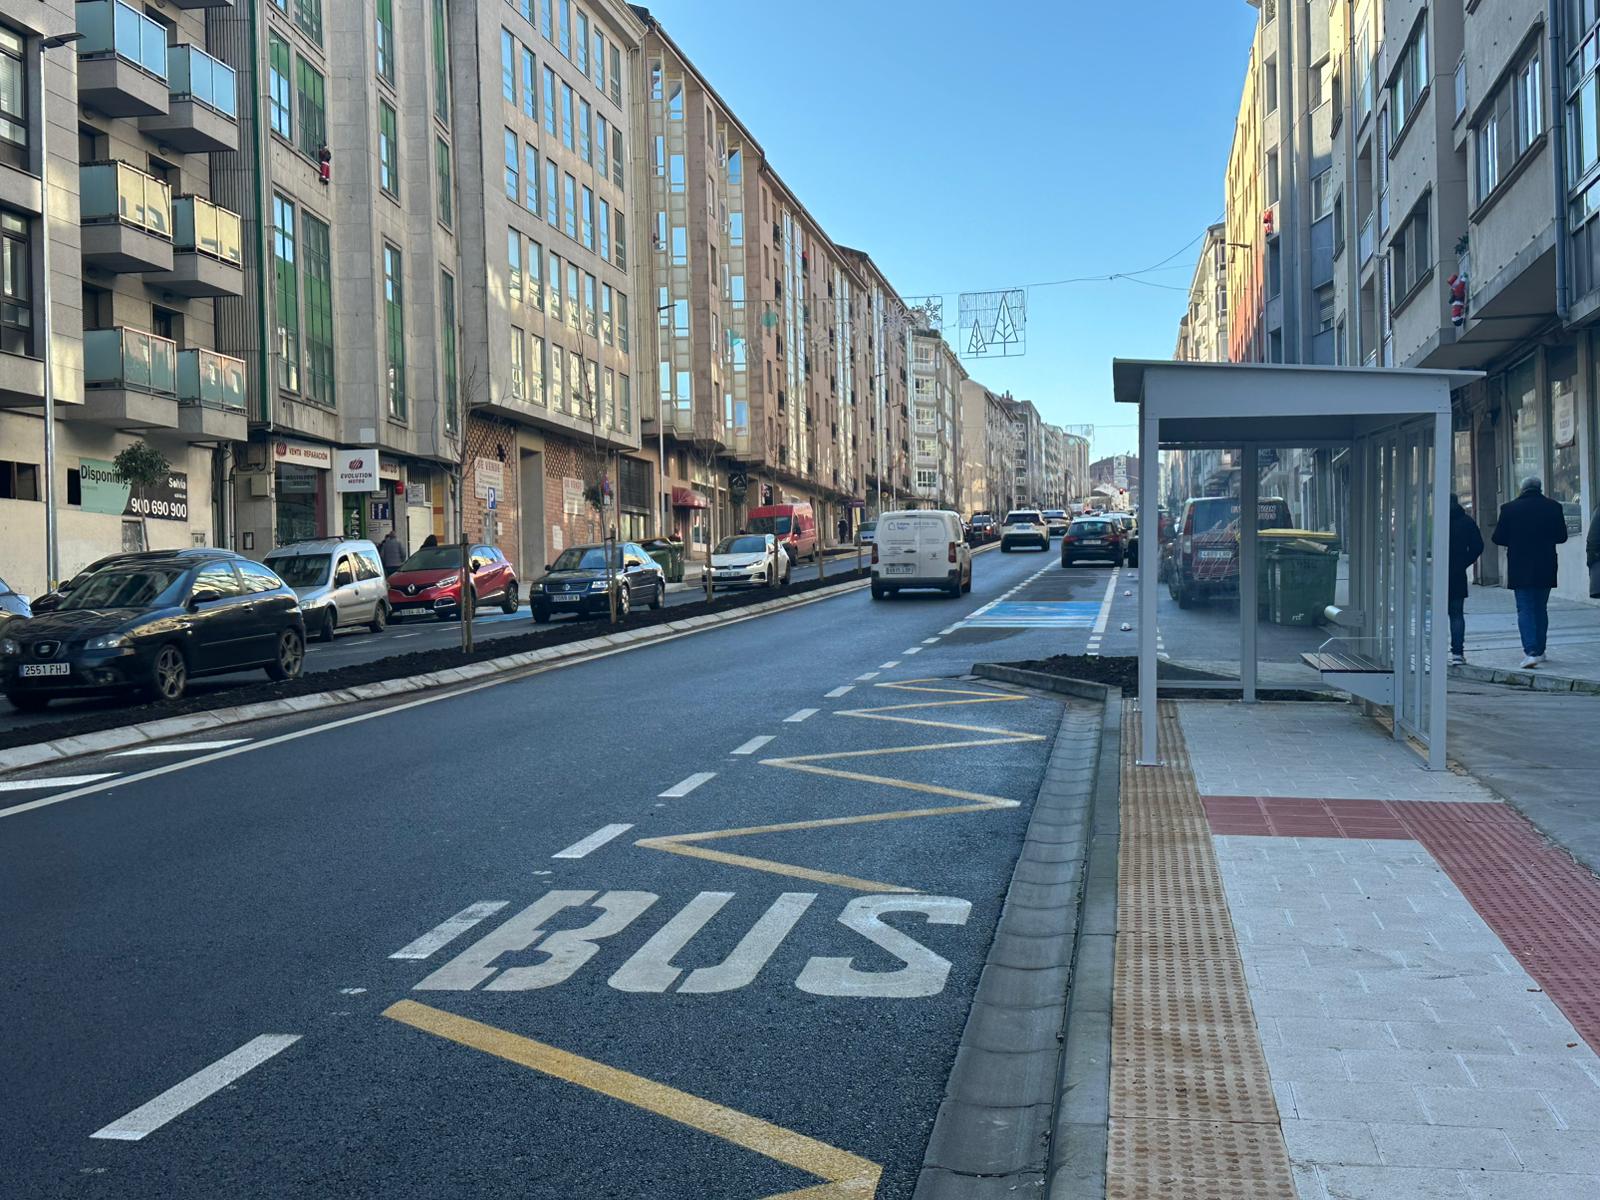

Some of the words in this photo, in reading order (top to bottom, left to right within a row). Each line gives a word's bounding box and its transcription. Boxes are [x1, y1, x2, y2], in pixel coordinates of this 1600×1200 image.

[131, 498, 150, 514] 900
[151, 499, 169, 516] 690
[170, 502, 187, 518] 900
[489, 488, 495, 508] P
[24, 665, 47, 676] 2551
[49, 664, 68, 674] FHJ
[411, 889, 974, 999] BUS
